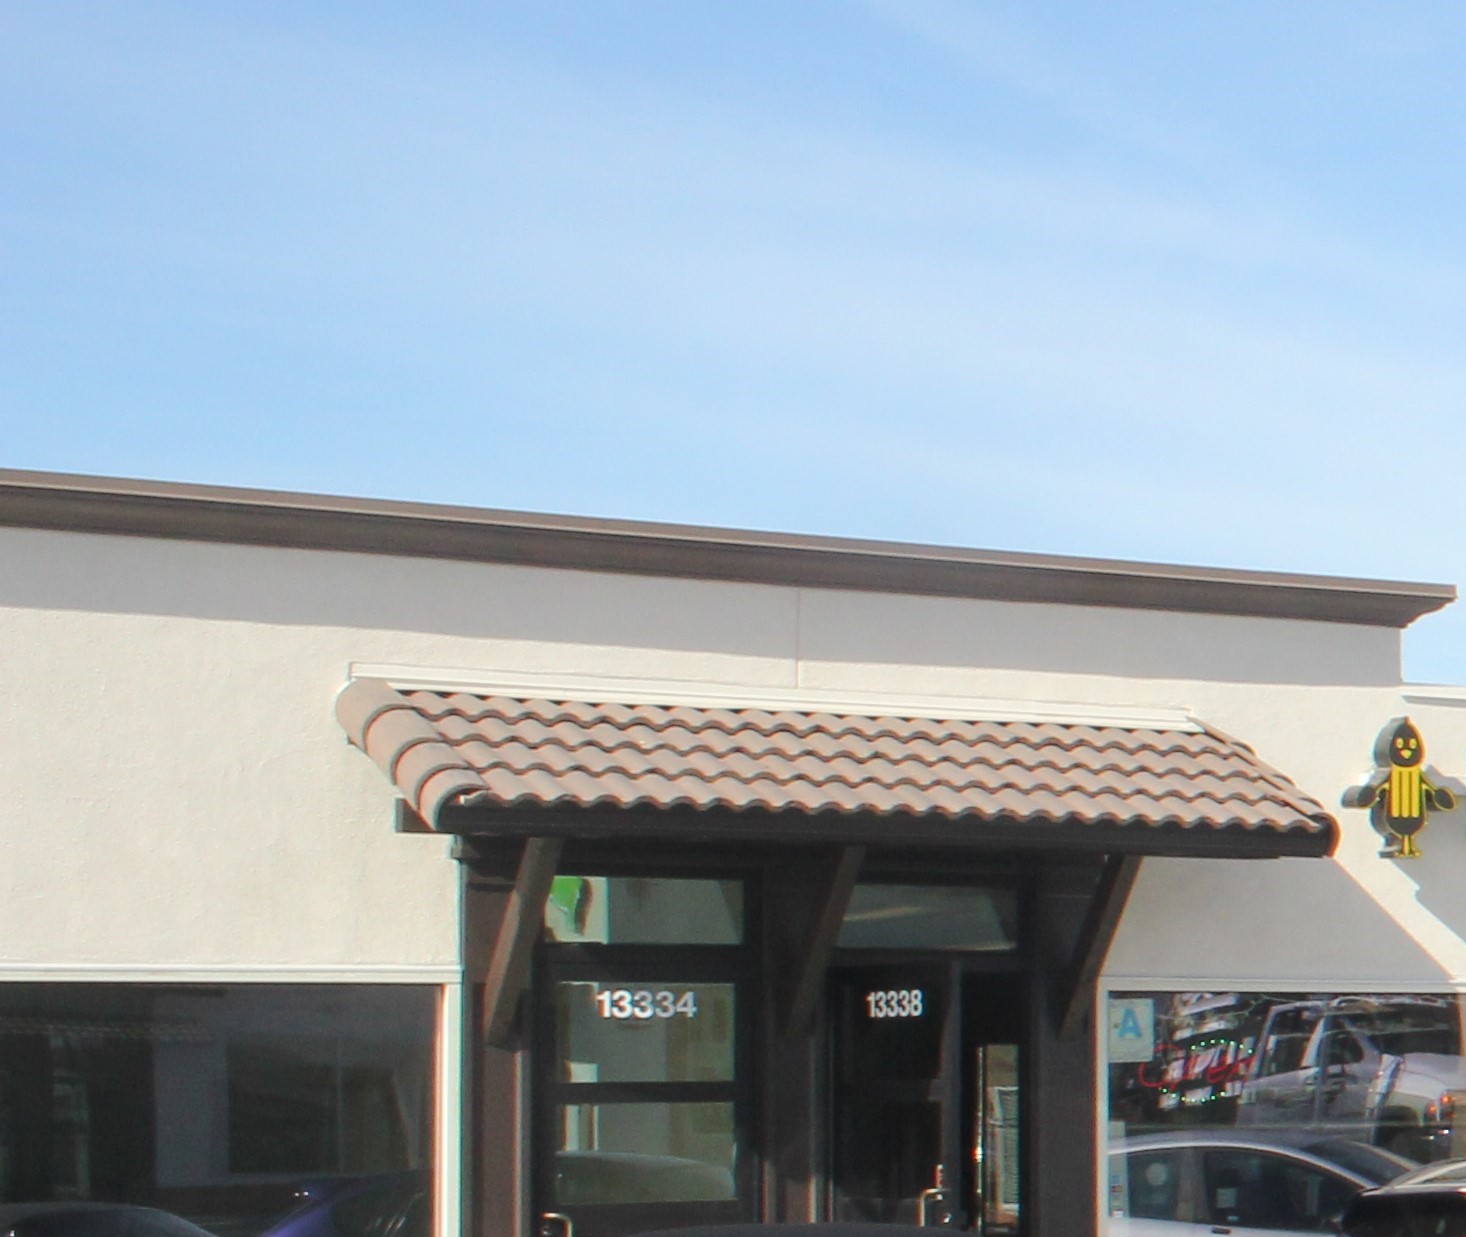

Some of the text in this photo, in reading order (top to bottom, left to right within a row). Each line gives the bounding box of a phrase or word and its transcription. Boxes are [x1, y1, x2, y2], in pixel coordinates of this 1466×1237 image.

[597, 990, 697, 1018] 13334
[865, 990, 923, 1018] 13338
[1118, 1008, 1143, 1038] A
